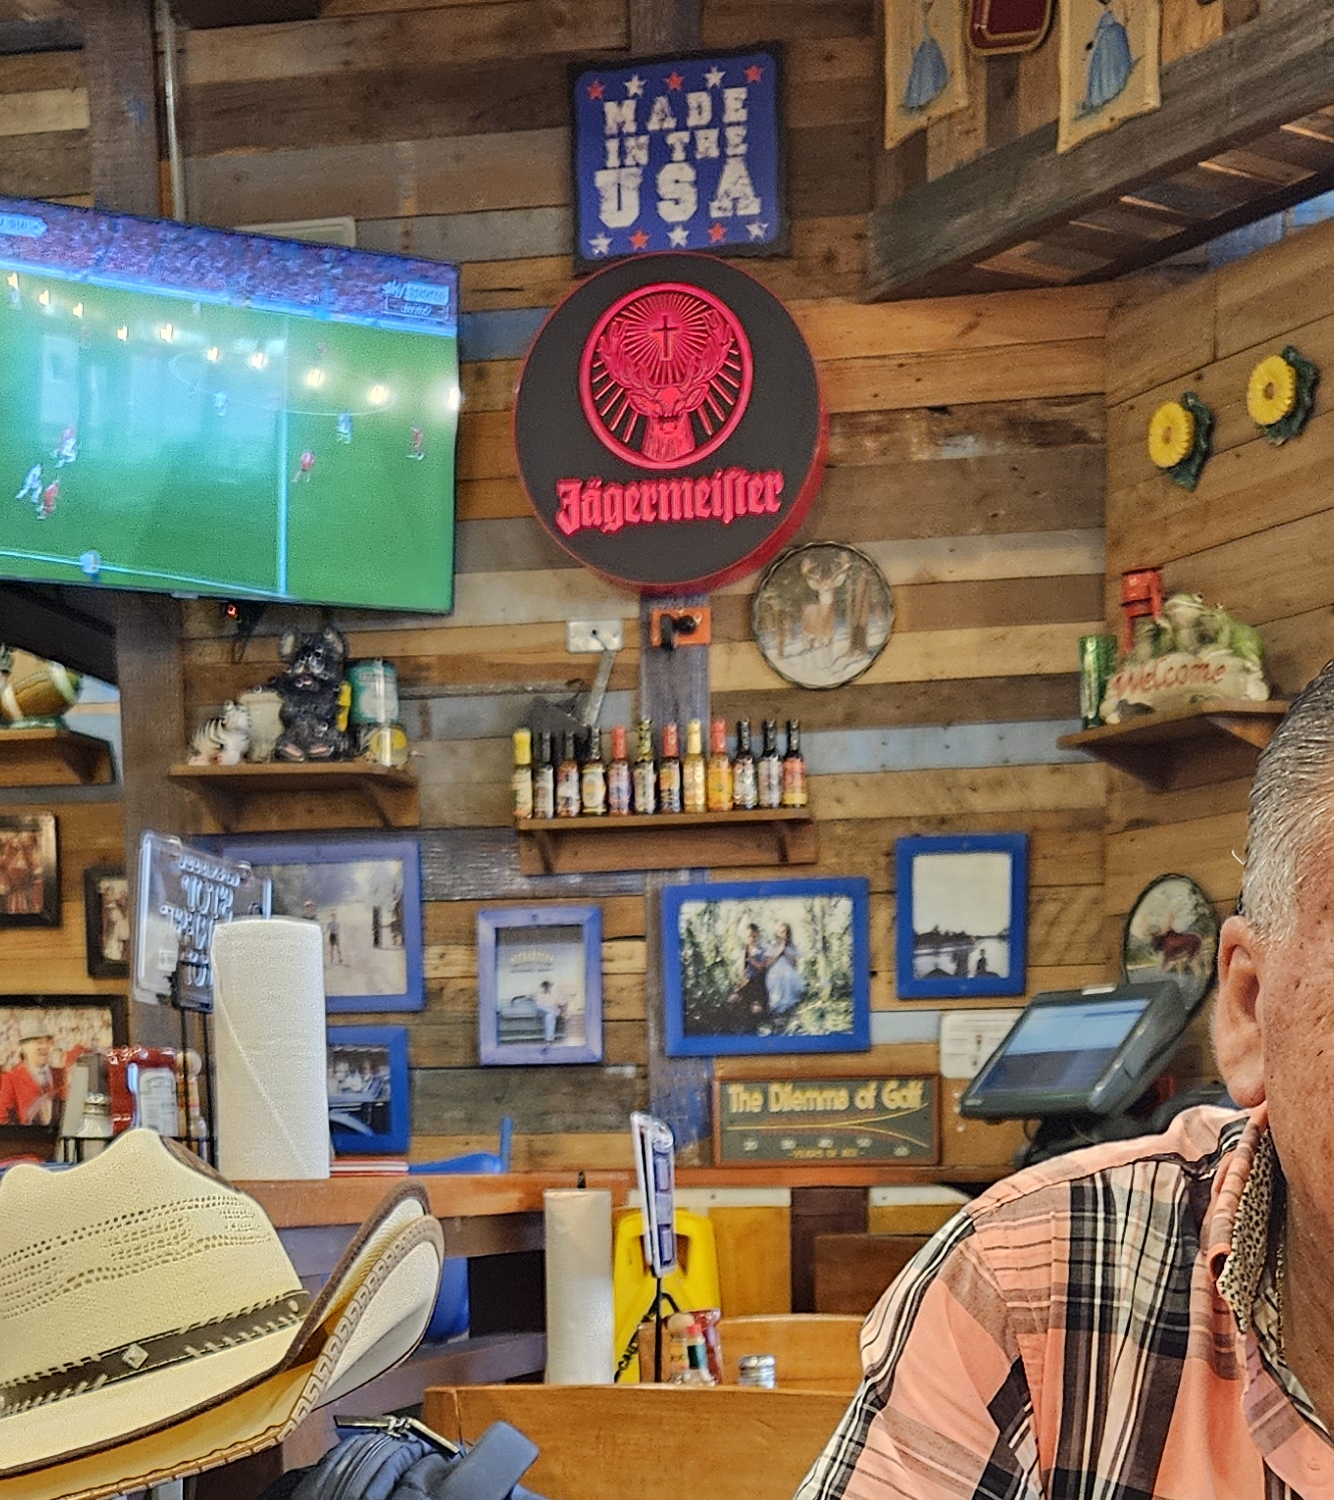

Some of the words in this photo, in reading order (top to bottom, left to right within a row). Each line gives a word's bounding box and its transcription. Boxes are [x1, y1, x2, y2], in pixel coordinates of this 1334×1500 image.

[604, 86, 748, 134] MADE
[605, 135, 649, 168] IN
[665, 125, 748, 161] THE
[594, 157, 761, 228] USA
[726, 1081, 764, 1113] The
[768, 1081, 851, 1113] Dilemma
[854, 1080, 878, 1110] of
[881, 1079, 924, 1110] Golf
